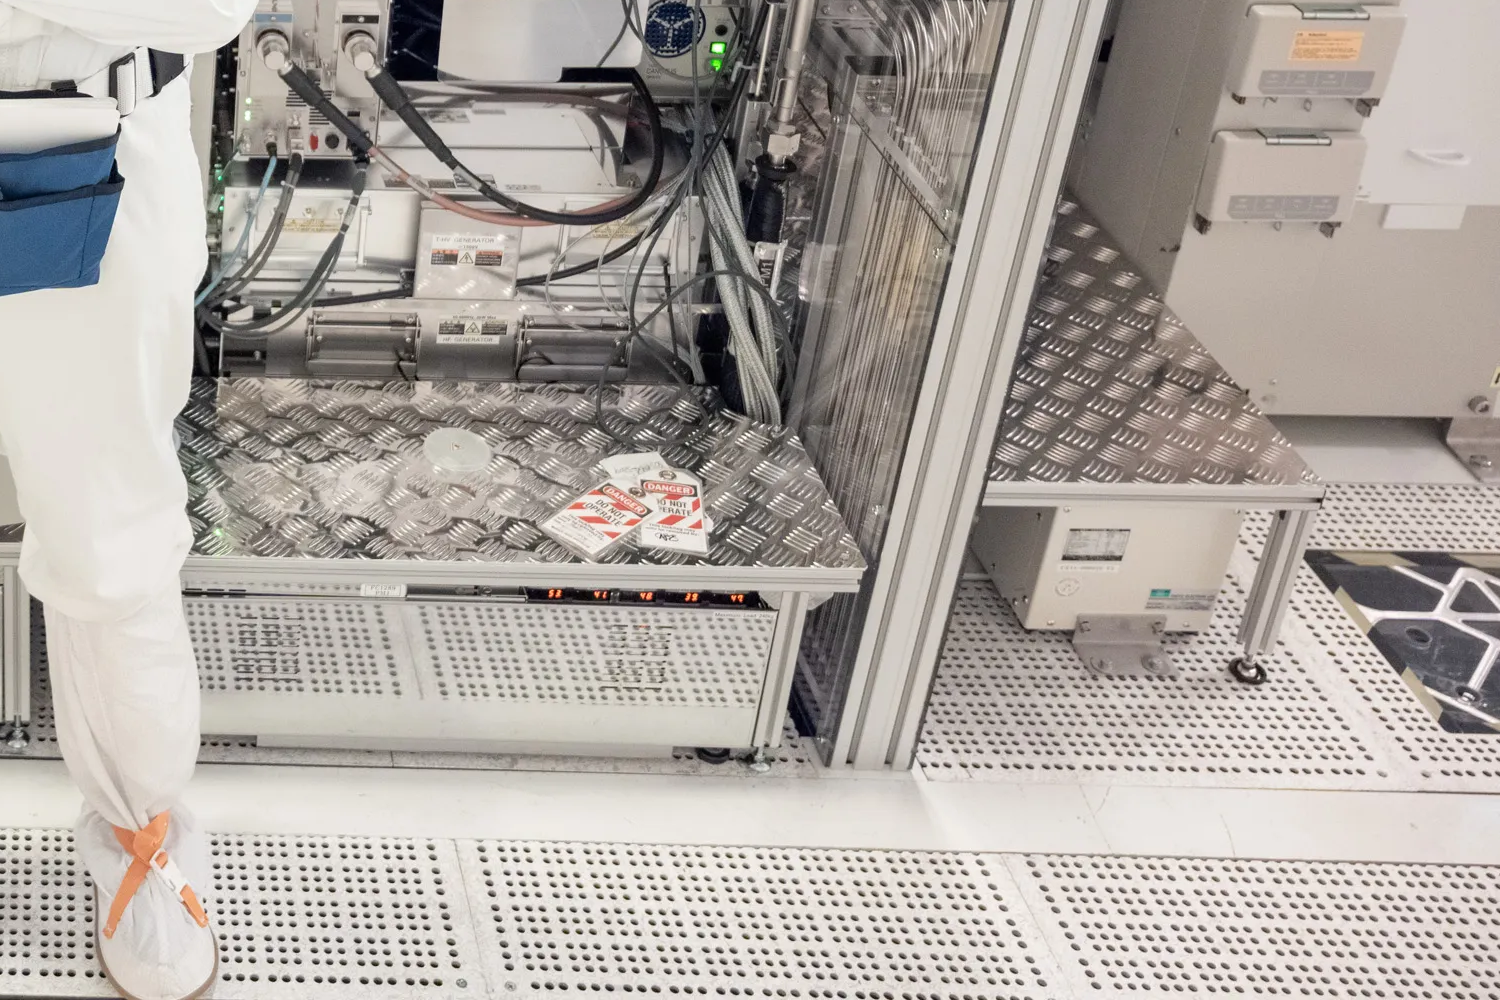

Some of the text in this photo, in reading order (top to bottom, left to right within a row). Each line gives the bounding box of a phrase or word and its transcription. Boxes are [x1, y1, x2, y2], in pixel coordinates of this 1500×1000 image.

[760, 262, 773, 287] PM1
[648, 482, 691, 495] DANGER
[595, 499, 627, 520] DO NOT
[605, 488, 645, 514] DANGER
[670, 500, 687, 509] NOT
[585, 502, 624, 528] OPERATE
[659, 507, 693, 517] ERATE
